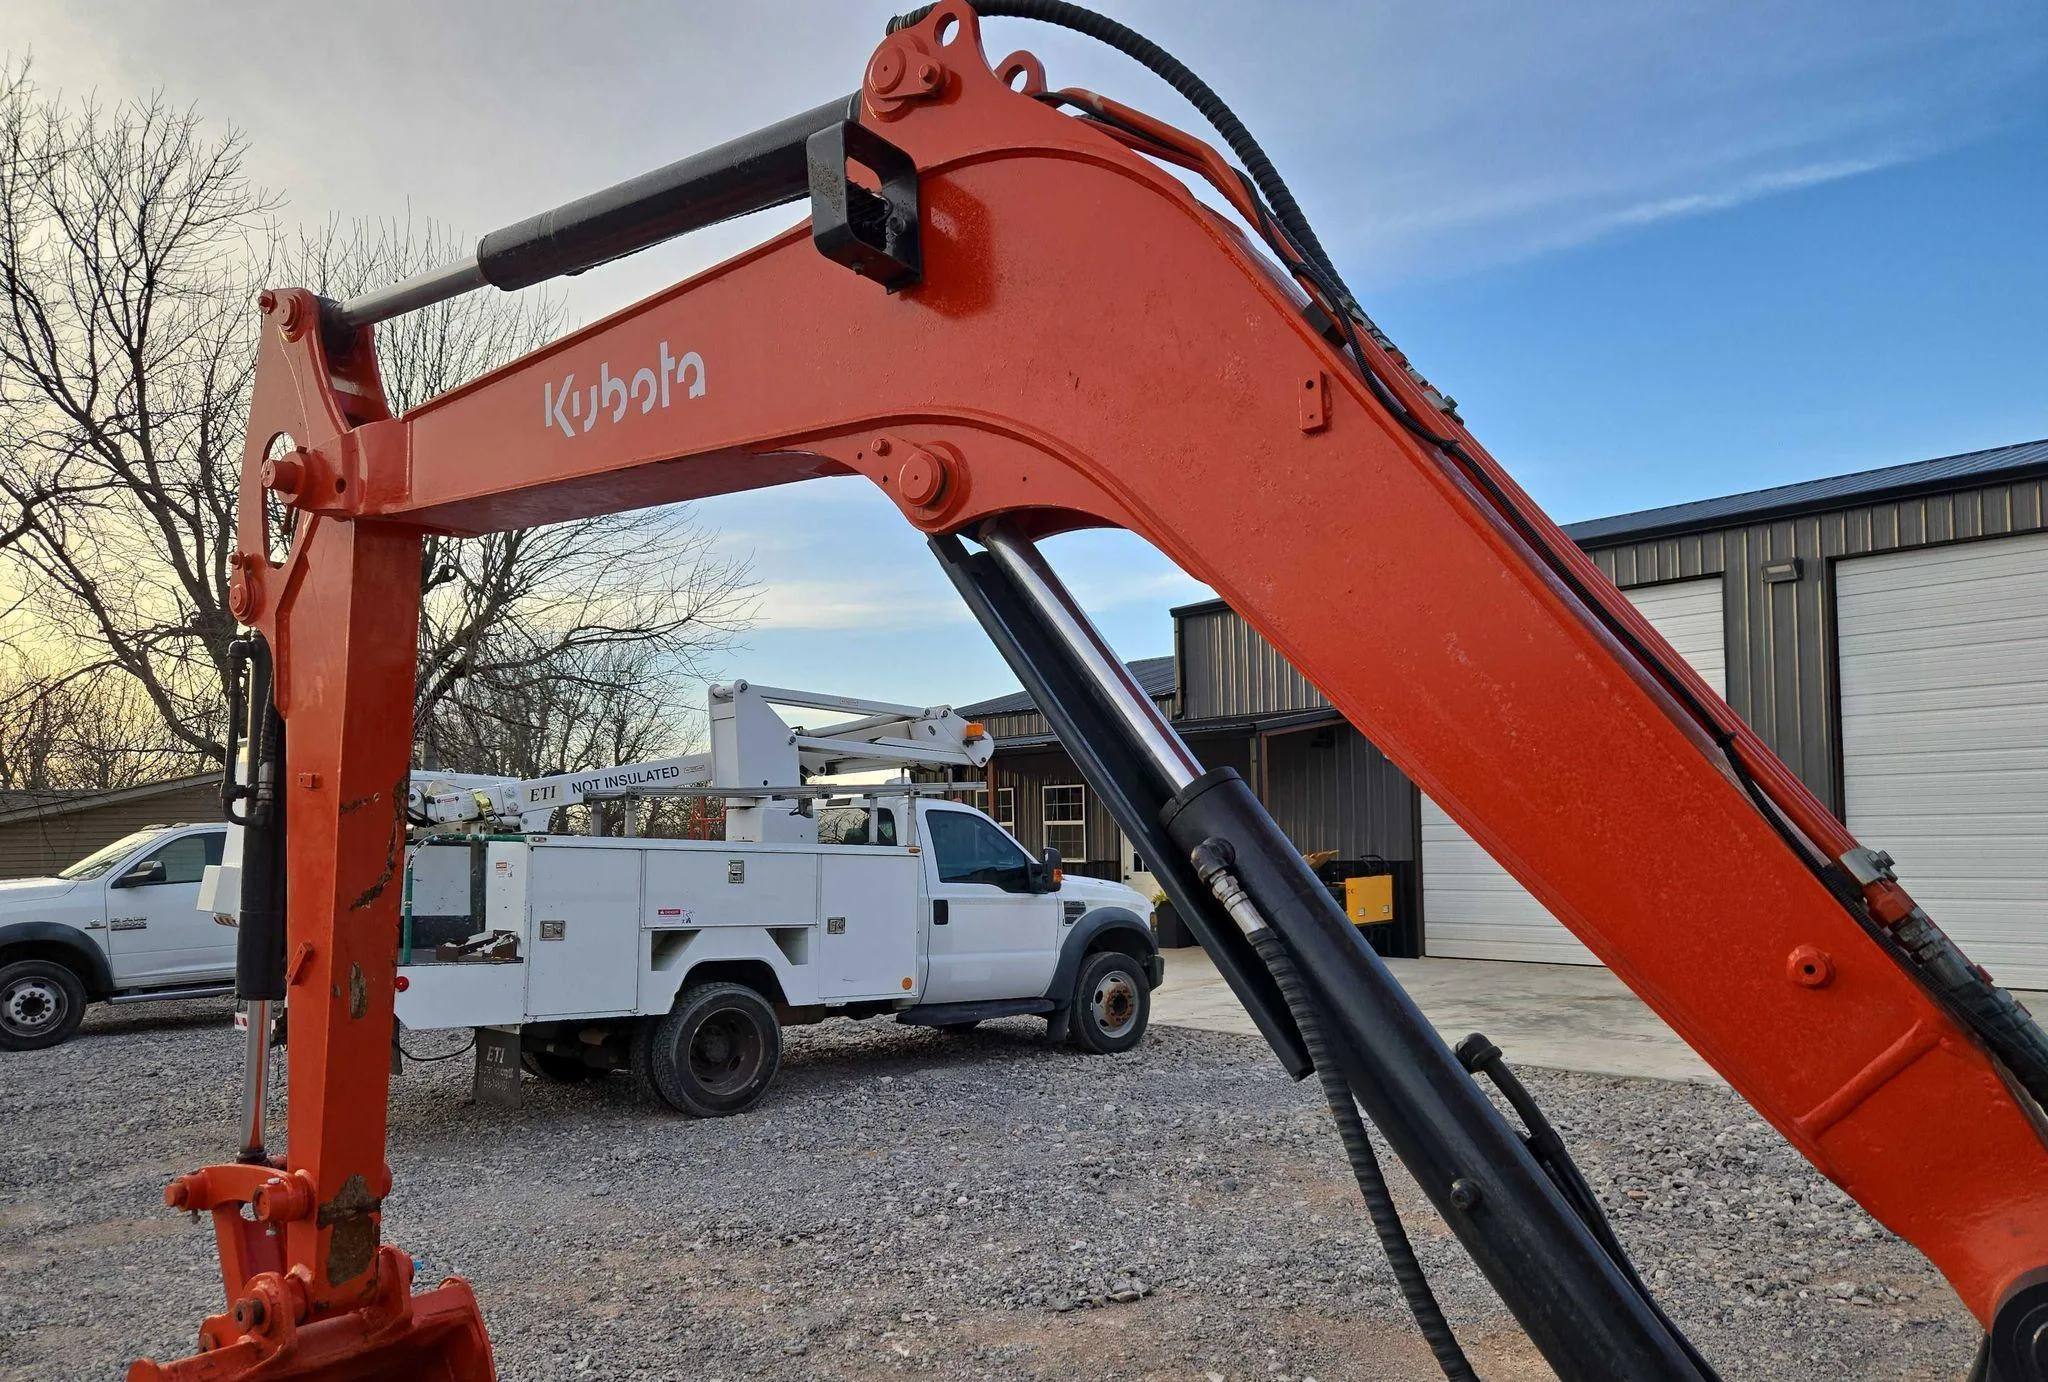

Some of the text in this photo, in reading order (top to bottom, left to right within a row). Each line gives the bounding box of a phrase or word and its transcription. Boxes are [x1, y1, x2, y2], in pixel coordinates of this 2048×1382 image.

[544, 340, 706, 438] Kubota
[571, 778, 600, 794] NOT
[604, 766, 680, 789] INSULATED
[530, 785, 556, 802] ETI
[486, 1046, 505, 1064] ETI
